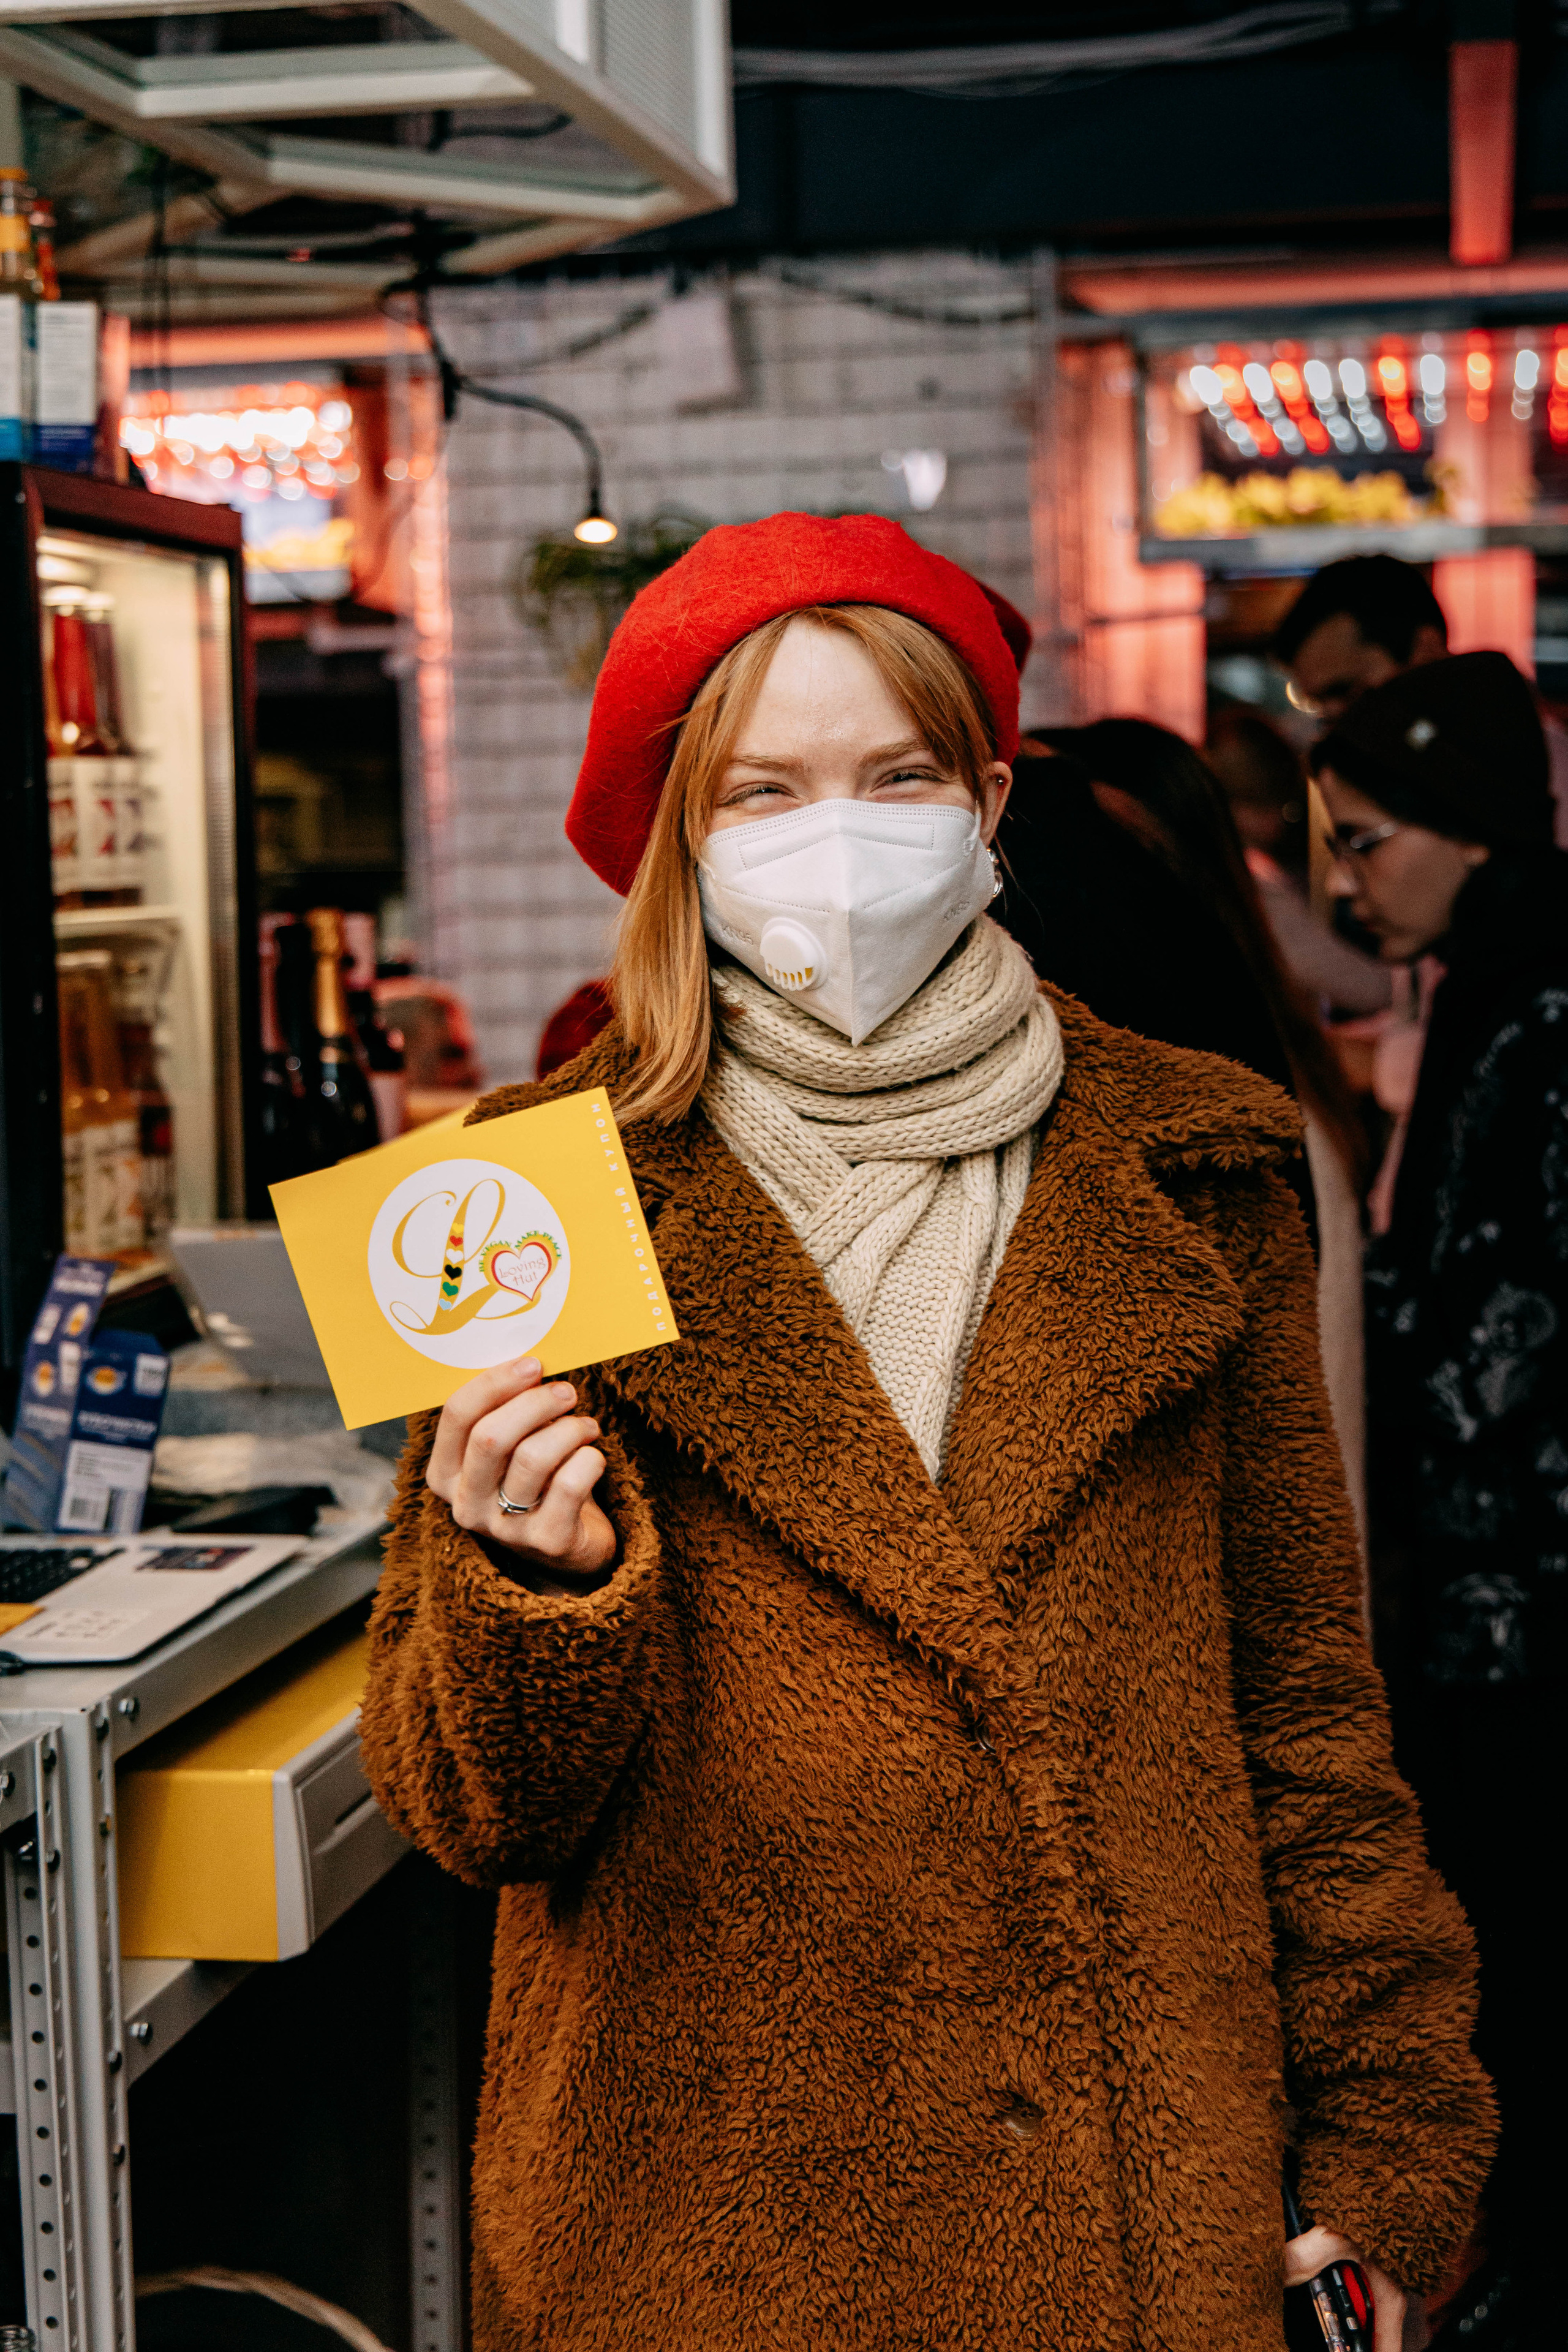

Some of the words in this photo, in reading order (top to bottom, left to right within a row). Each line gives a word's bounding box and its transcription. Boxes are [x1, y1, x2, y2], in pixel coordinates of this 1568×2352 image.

[722, 924, 754, 946] KN95
[591, 1103, 619, 1172] КУПОН
[481, 1240, 513, 1256] VEGAN
[514, 1231, 539, 1249] MAKE
[543, 1232, 562, 1259] PEACE
[479, 1260, 484, 1272] BE
[499, 1257, 546, 1278] Loving
[614, 1187, 667, 1331] ПОДАРОЧНЫЙ
[513, 1272, 538, 1286] Hut
